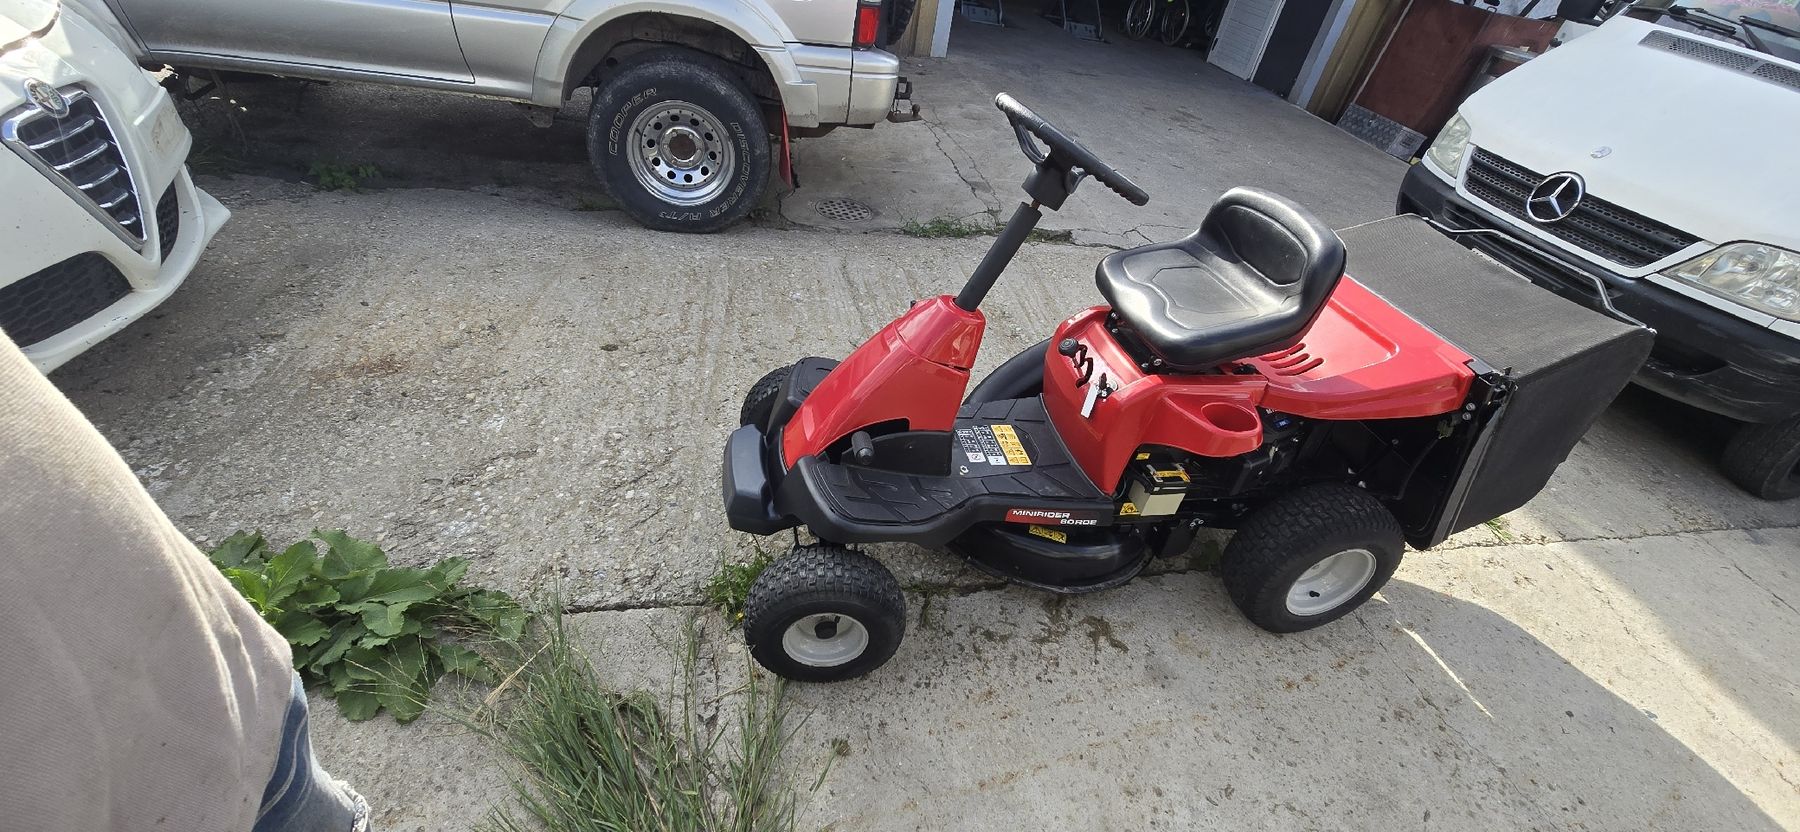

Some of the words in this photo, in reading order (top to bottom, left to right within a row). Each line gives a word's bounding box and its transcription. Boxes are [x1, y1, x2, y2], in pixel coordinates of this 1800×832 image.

[609, 87, 657, 155] COOPER
[710, 122, 750, 217] DISCOVERER
[1012, 510, 1071, 519] MINIRIDER
